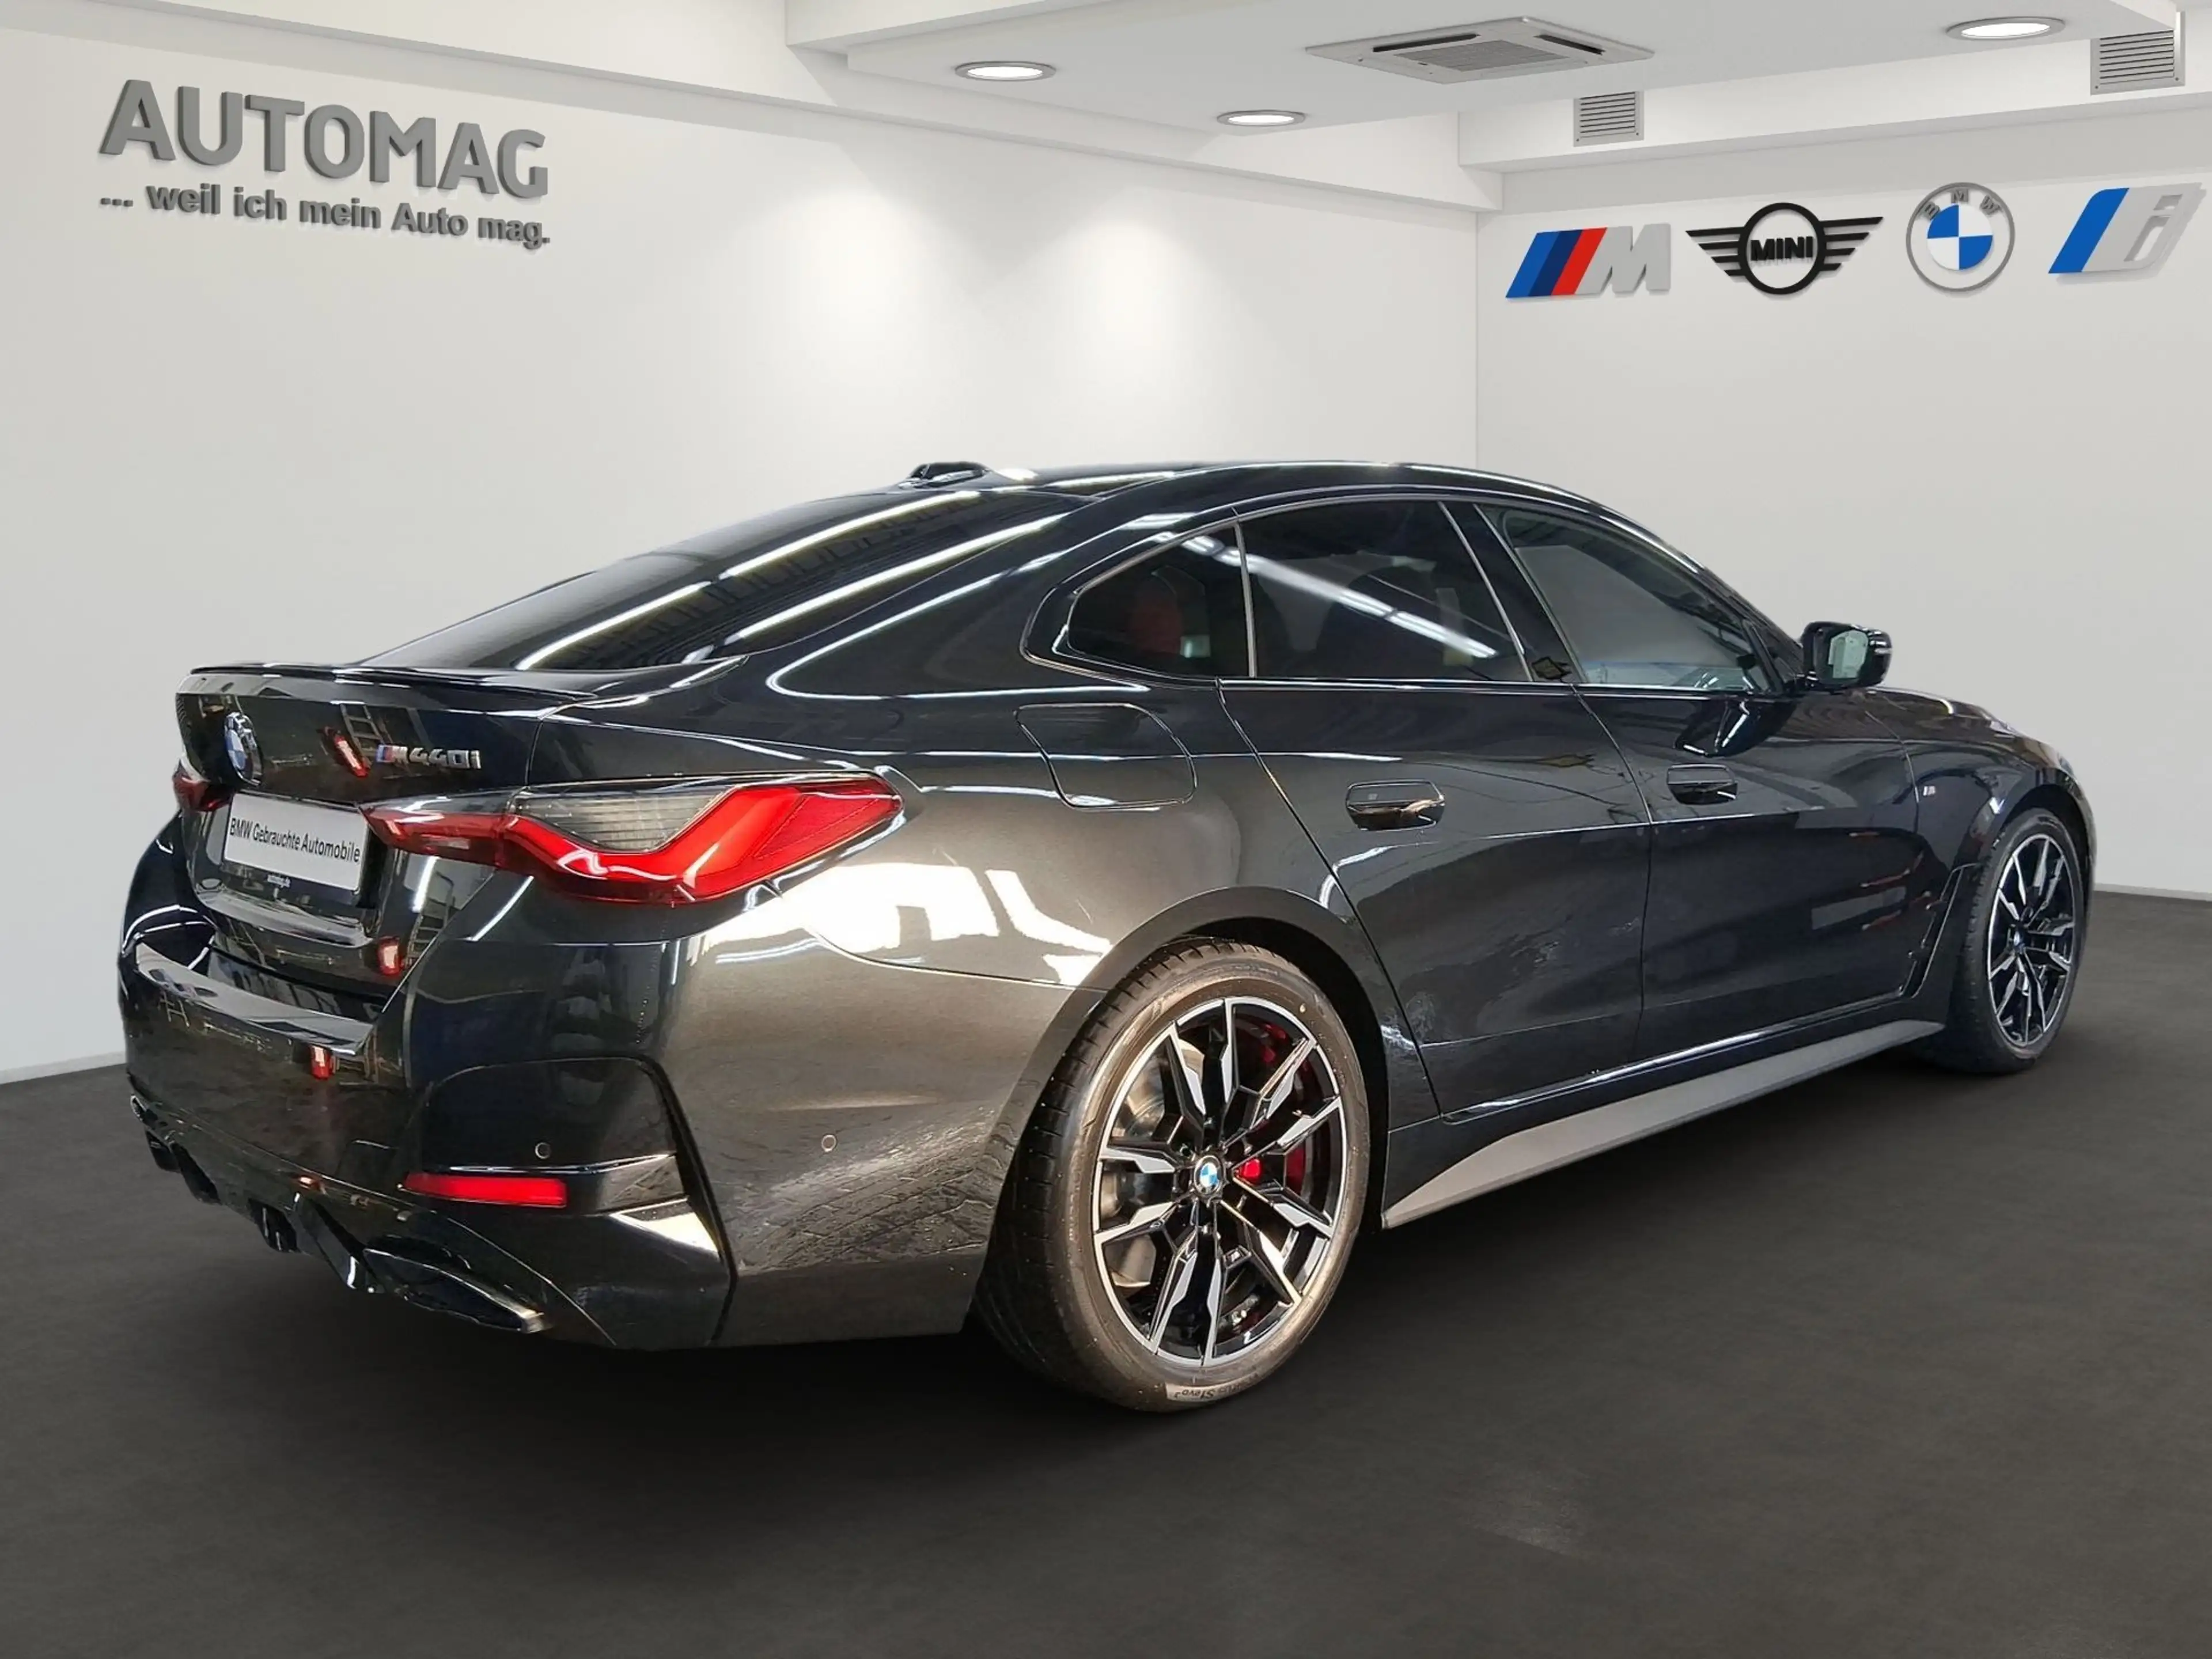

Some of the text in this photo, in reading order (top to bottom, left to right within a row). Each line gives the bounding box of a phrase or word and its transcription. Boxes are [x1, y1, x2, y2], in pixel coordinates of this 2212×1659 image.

[99, 79, 548, 199] AUTOMAG
[146, 183, 221, 215] weil
[233, 186, 287, 221] ich
[300, 197, 381, 229] mein
[391, 202, 469, 237] Auto
[478, 215, 551, 250] mag.
[1922, 187, 2003, 221] BMW
[1574, 223, 1671, 295] M
[1750, 234, 1814, 263] MINI
[230, 817, 361, 862] BMW Gebrauchte Automobile
